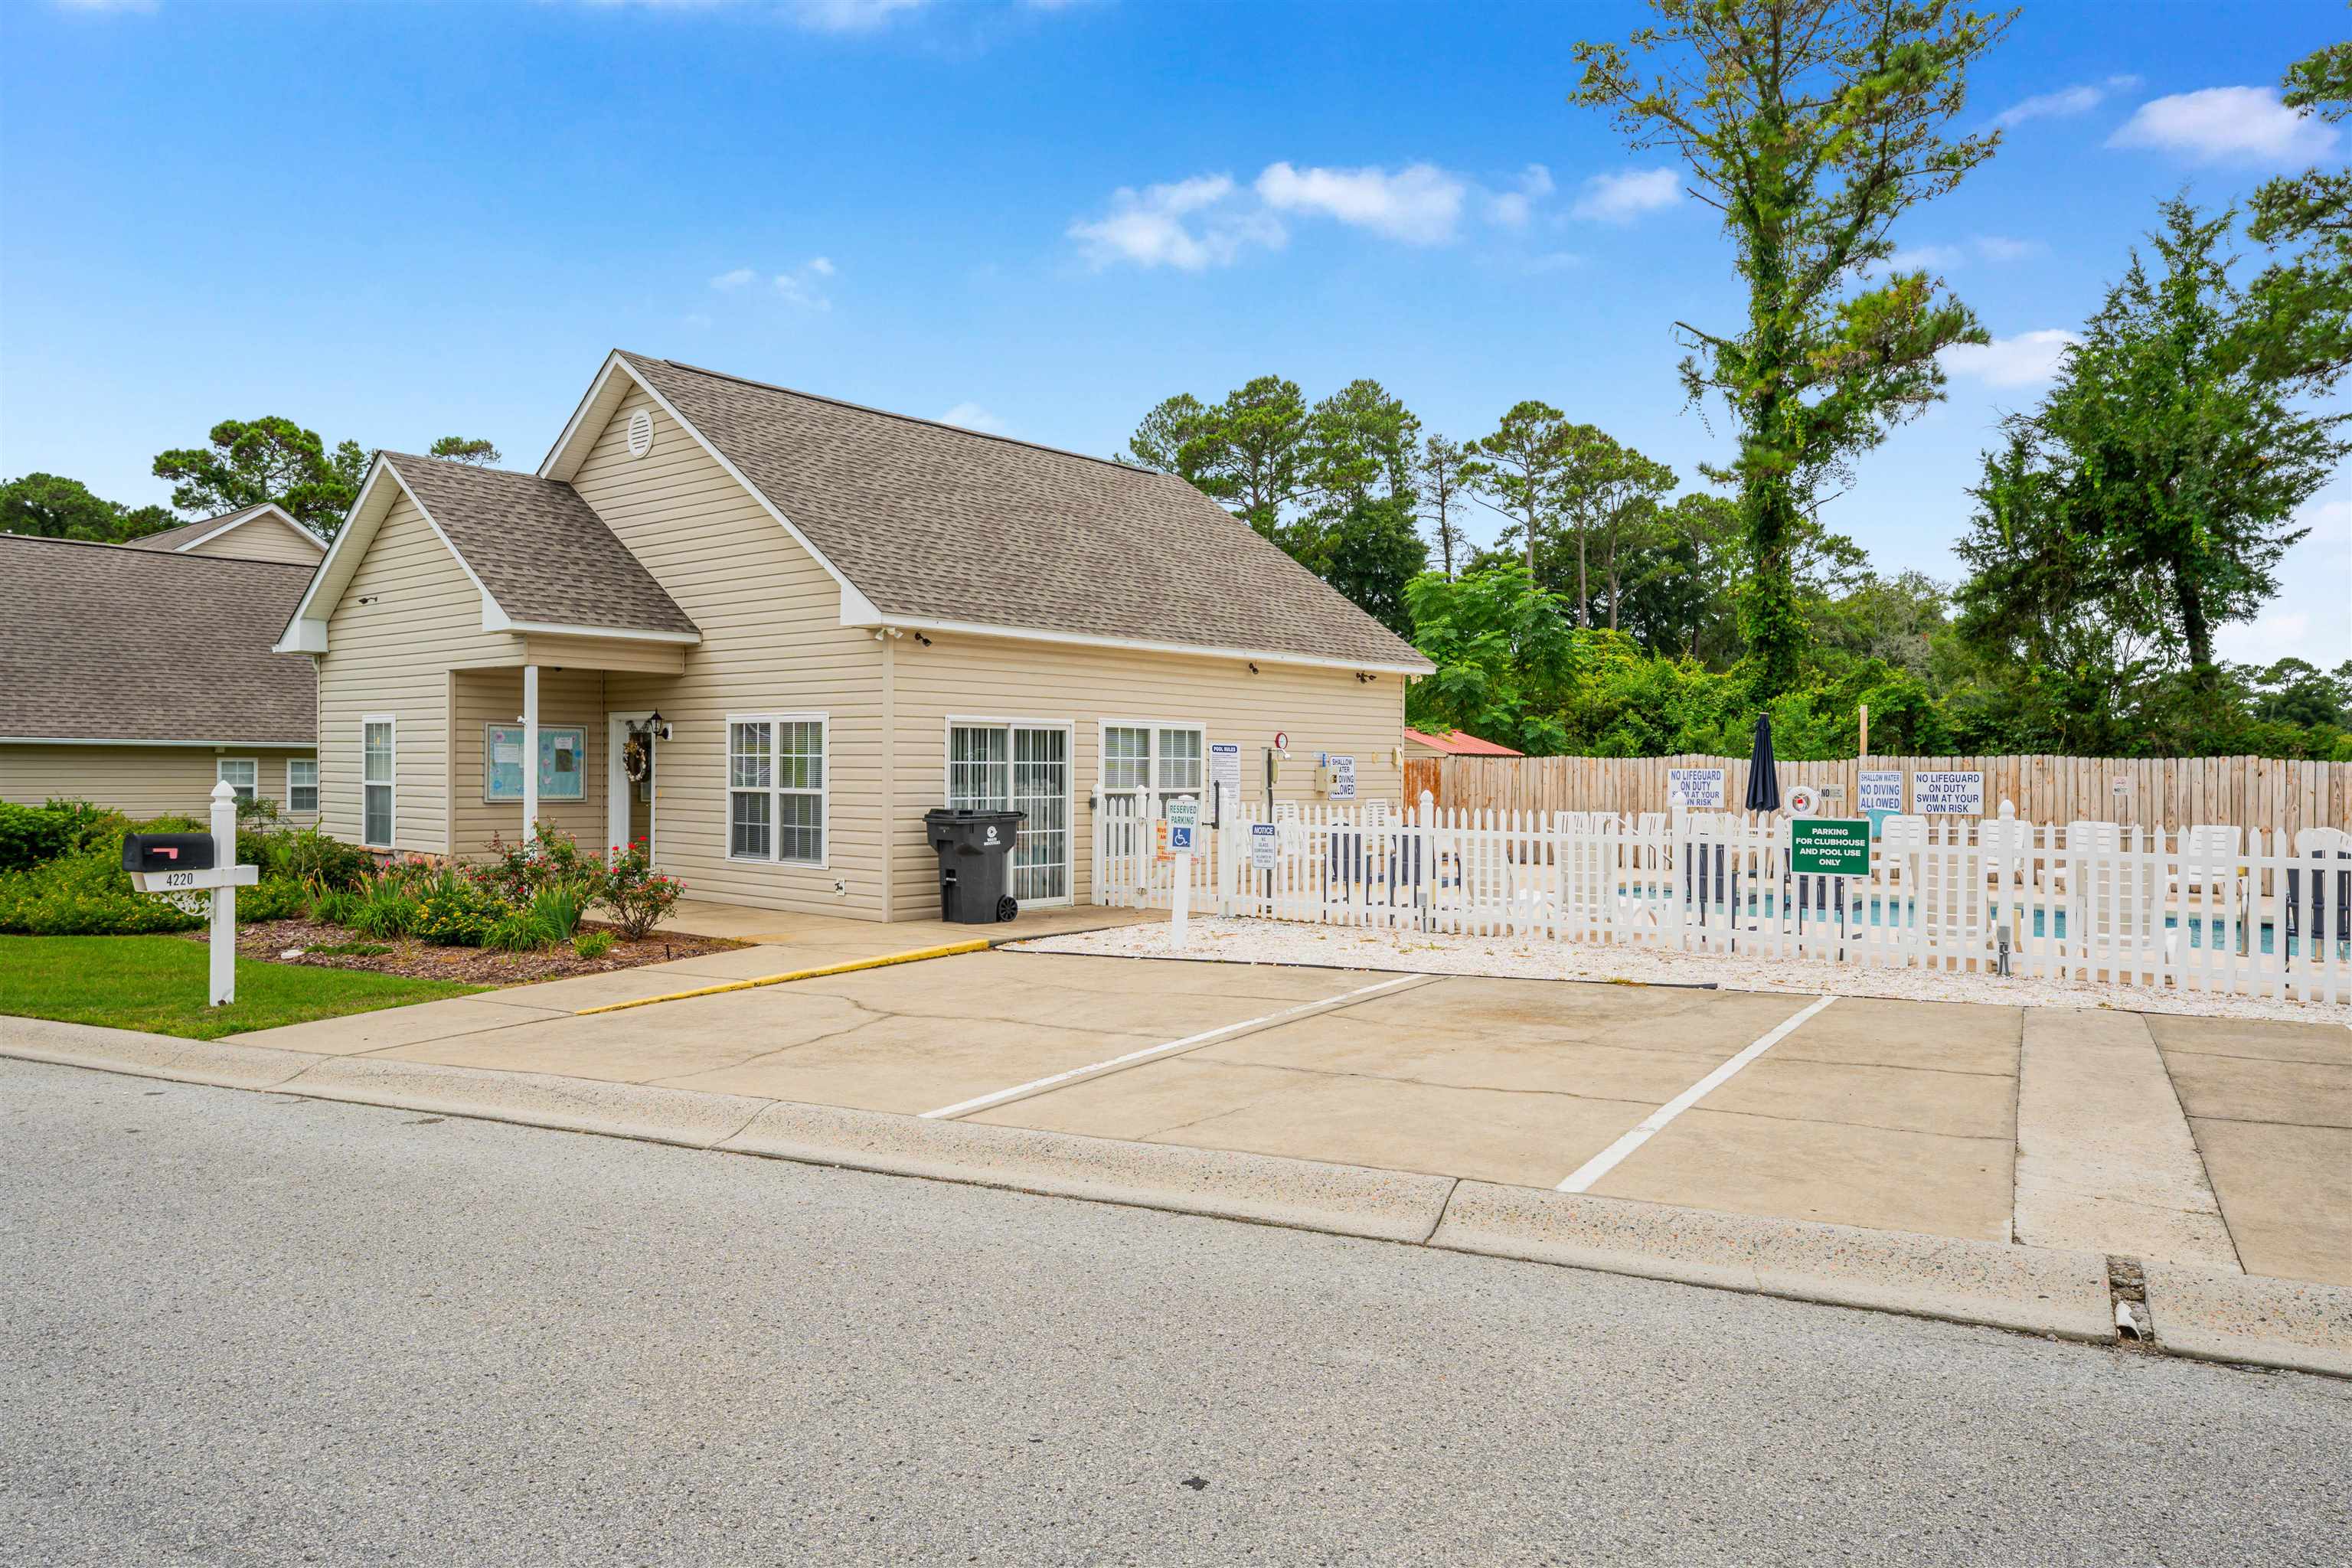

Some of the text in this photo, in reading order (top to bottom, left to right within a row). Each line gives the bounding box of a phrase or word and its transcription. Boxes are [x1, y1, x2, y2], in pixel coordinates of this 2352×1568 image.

[1671, 770, 1721, 780] NO LIFEGUARD
[1916, 774, 1980, 782] NO LIFEGUARD
[1331, 784, 1354, 795] OWED
[1681, 781, 1710, 791] ON DUTY
[1861, 784, 1900, 795] NO DIVING
[1929, 784, 1966, 792] ON DUTY
[1821, 789, 1830, 797] NO
[1860, 797, 1900, 808] ALLOWED
[1916, 794, 1979, 802] SWIM AT YOUR
[1169, 805, 1197, 814] RESERVED
[1926, 804, 1968, 812] OWN RISK
[1171, 815, 1194, 825] PARKING
[1814, 838, 1866, 846] CLUBHOUSE
[166, 873, 193, 887] 4220
